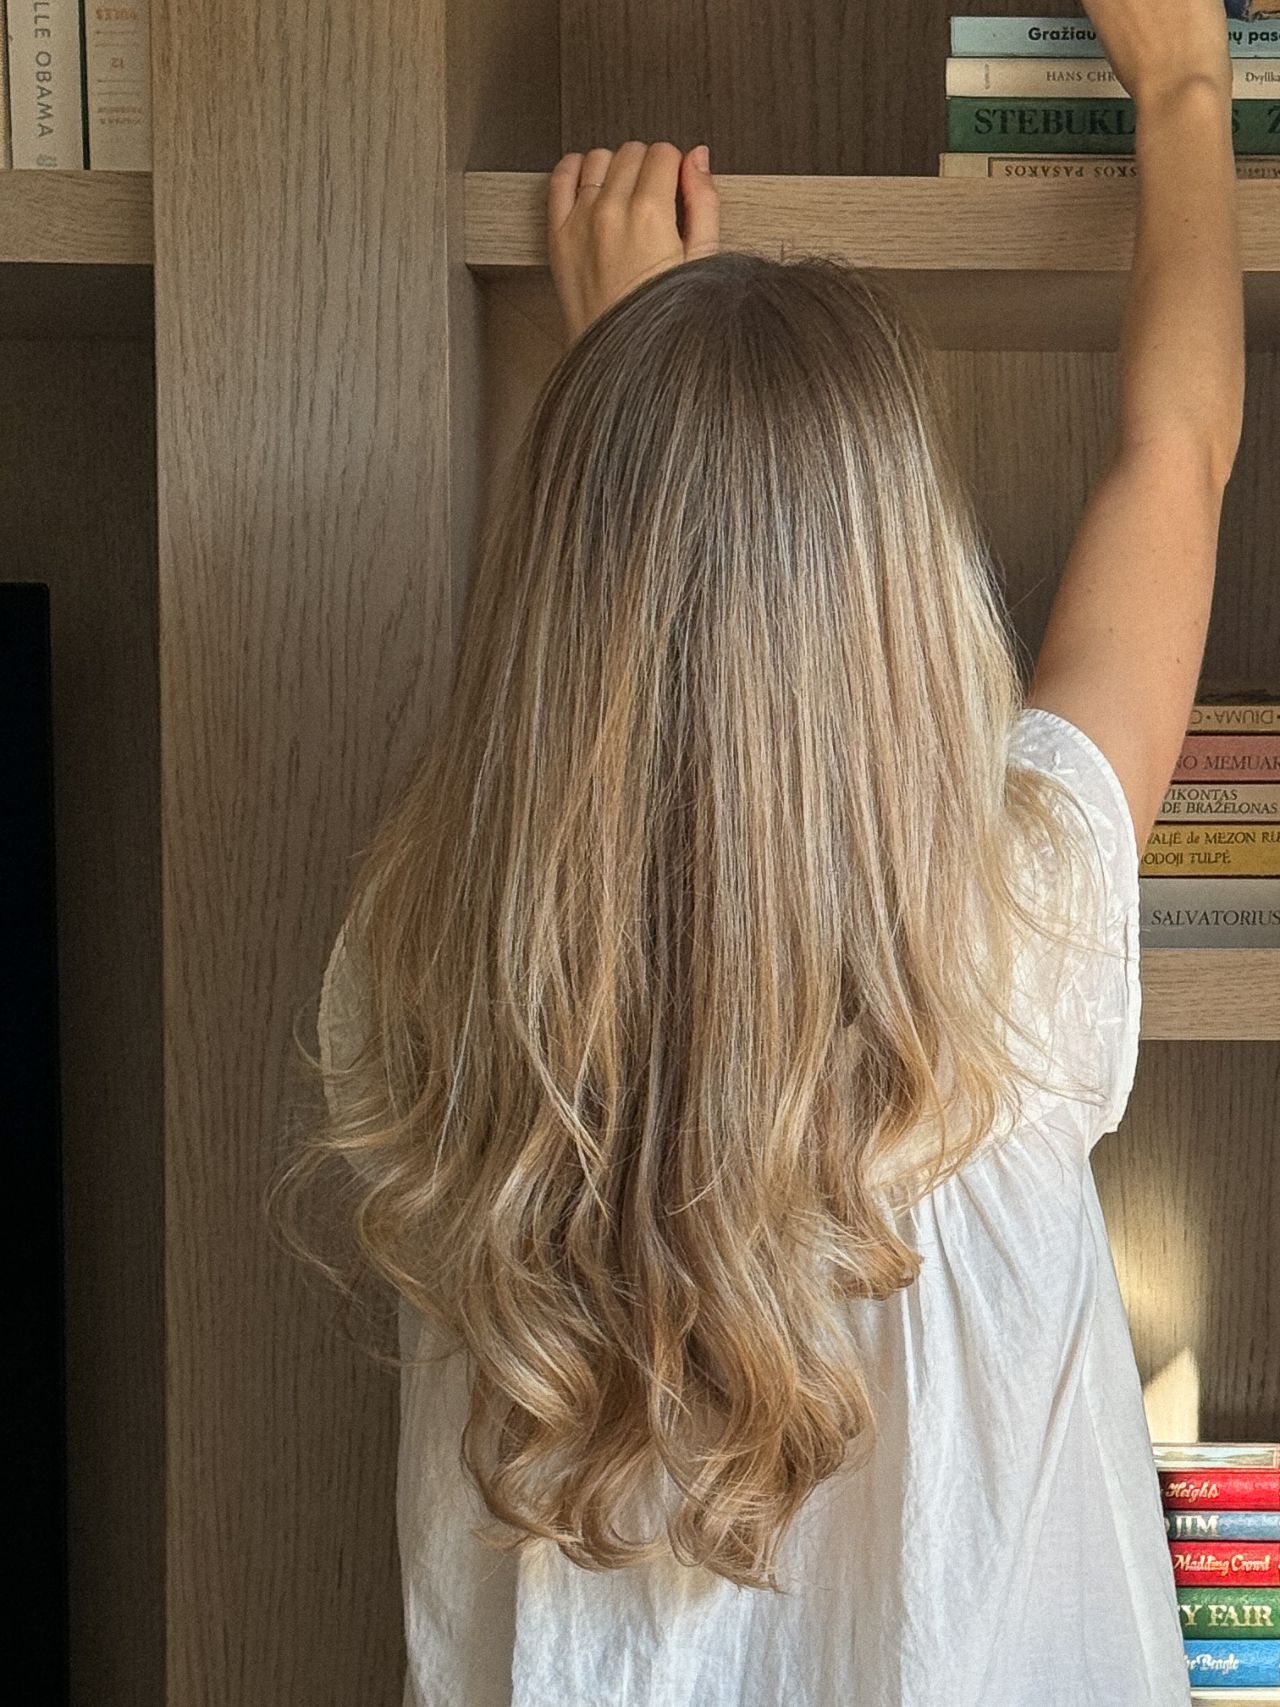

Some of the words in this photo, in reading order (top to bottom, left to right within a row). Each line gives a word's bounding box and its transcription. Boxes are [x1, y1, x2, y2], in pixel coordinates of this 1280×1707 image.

[1028, 26, 1097, 41] Gražiau
[1046, 71, 1082, 82] HANS
[35, 51, 54, 137] OBAMA
[974, 108, 1136, 135] STEBUKL
[1004, 165, 1083, 177] PASAKOS
[1162, 801, 1182, 814] DE
[1186, 800, 1278, 814] BRAŽELONAS
[1187, 831, 1200, 844] de
[1204, 831, 1256, 844] MEZON
[1165, 1481, 1220, 1503] Heights
[1174, 1515, 1219, 1538] JIM
[1173, 1553, 1229, 1577] Madding
[1231, 1554, 1271, 1572] Crowd
[1207, 1604, 1275, 1627] FAIR
